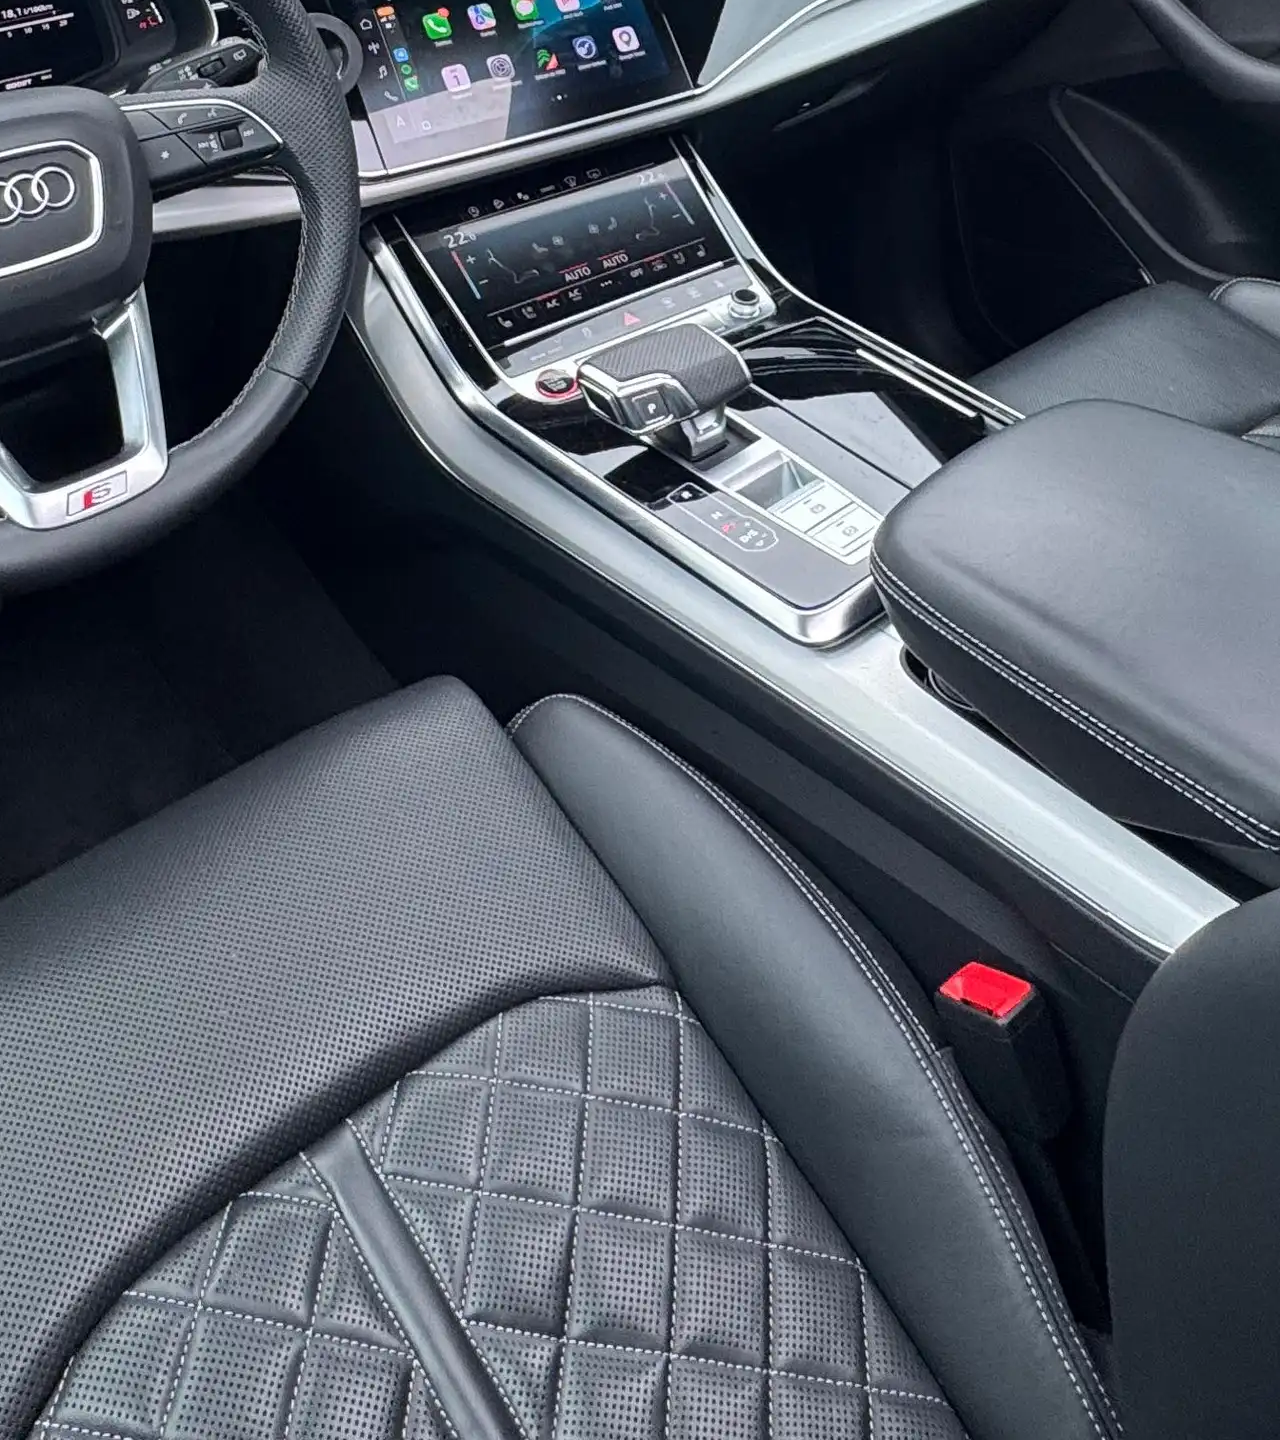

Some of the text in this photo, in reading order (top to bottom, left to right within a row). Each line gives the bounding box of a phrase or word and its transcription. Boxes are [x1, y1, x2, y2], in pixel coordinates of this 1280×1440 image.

[602, 253, 629, 269] AUTO
[564, 266, 592, 282] AUTO
[546, 299, 560, 309] AC
[647, 403, 657, 415] P
